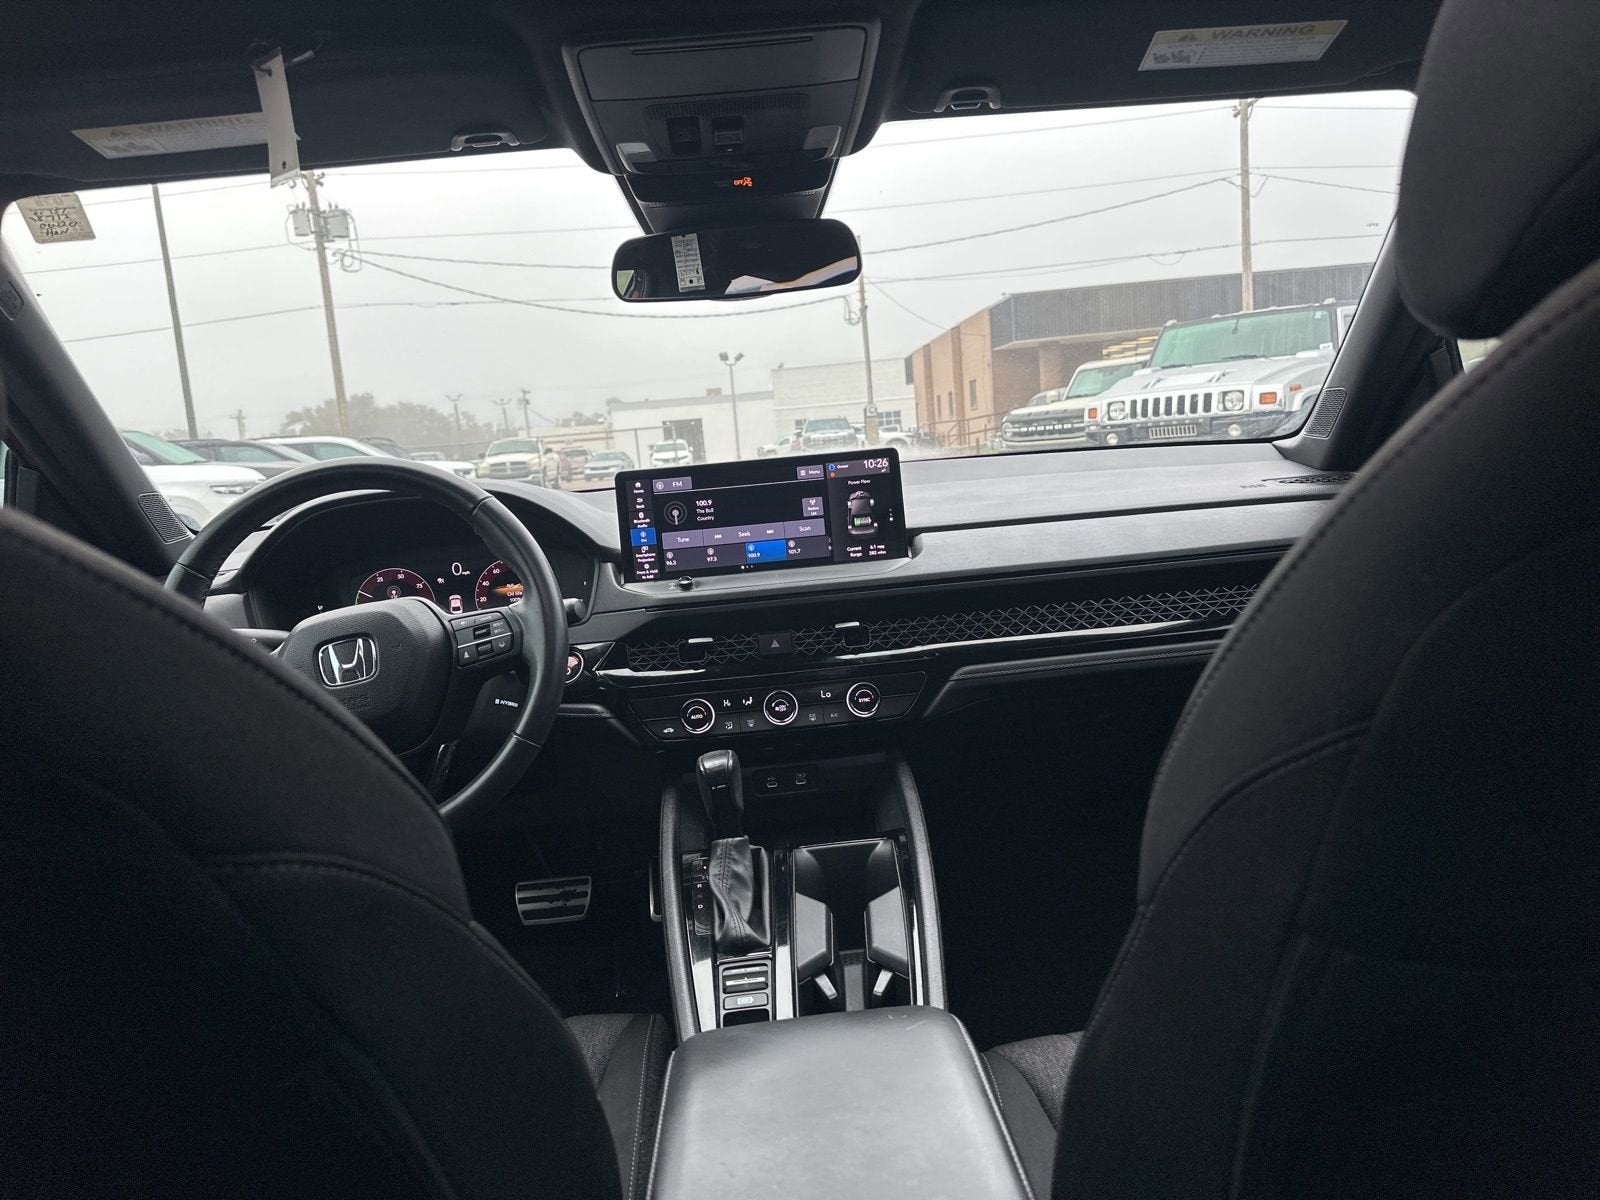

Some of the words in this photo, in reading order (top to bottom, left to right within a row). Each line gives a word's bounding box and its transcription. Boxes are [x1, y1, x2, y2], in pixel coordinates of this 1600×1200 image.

[1211, 24, 1316, 40] WARNING
[141, 116, 253, 133] WARNING
[1020, 423, 1072, 432] BRONCO
[863, 458, 888, 468] 10:26
[452, 562, 462, 576] 0
[820, 690, 831, 698] Lo
